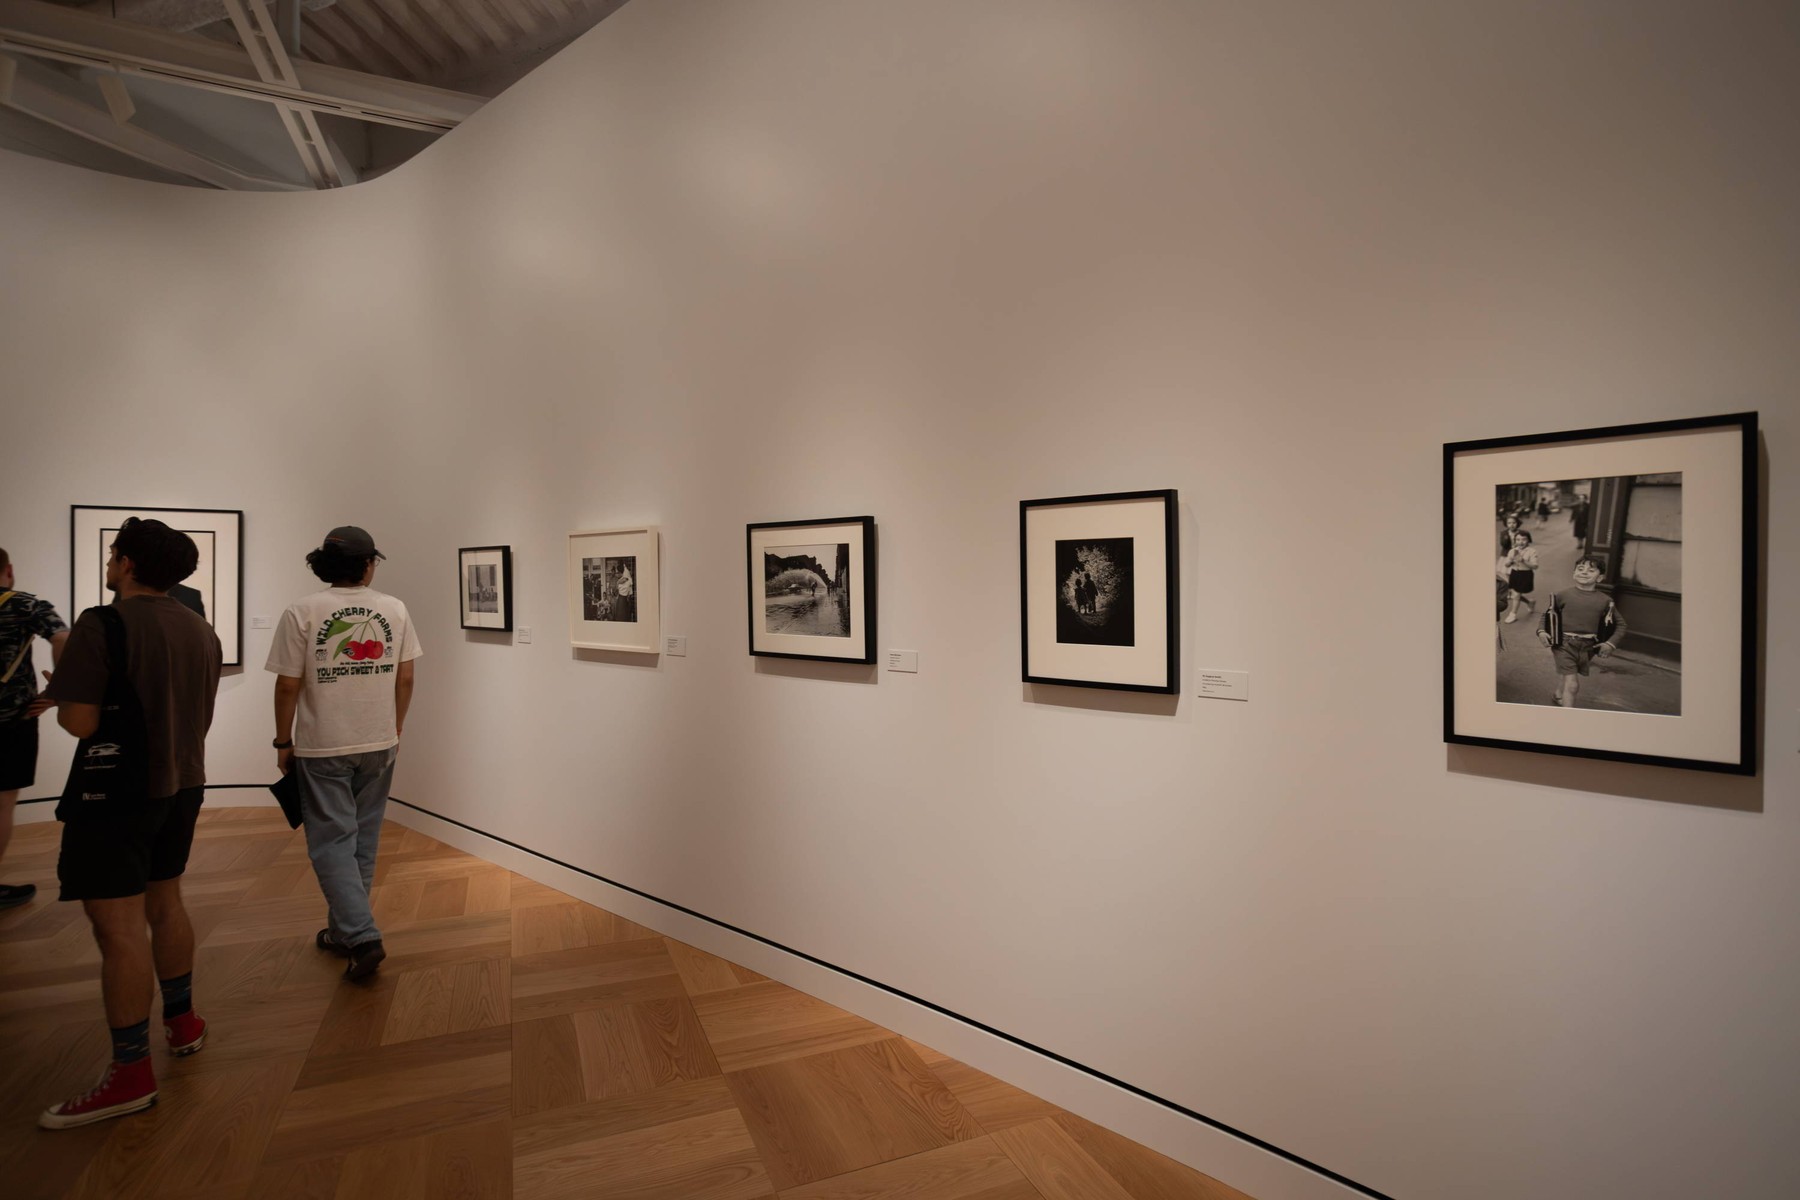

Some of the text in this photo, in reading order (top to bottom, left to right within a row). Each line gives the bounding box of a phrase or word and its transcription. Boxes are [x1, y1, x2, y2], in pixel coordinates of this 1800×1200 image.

[316, 607, 392, 645] WILD CHERRY FARMS
[316, 667, 331, 677] YOU
[332, 666, 349, 676] PICK
[350, 665, 373, 675] SWEET
[380, 664, 394, 673] TART
